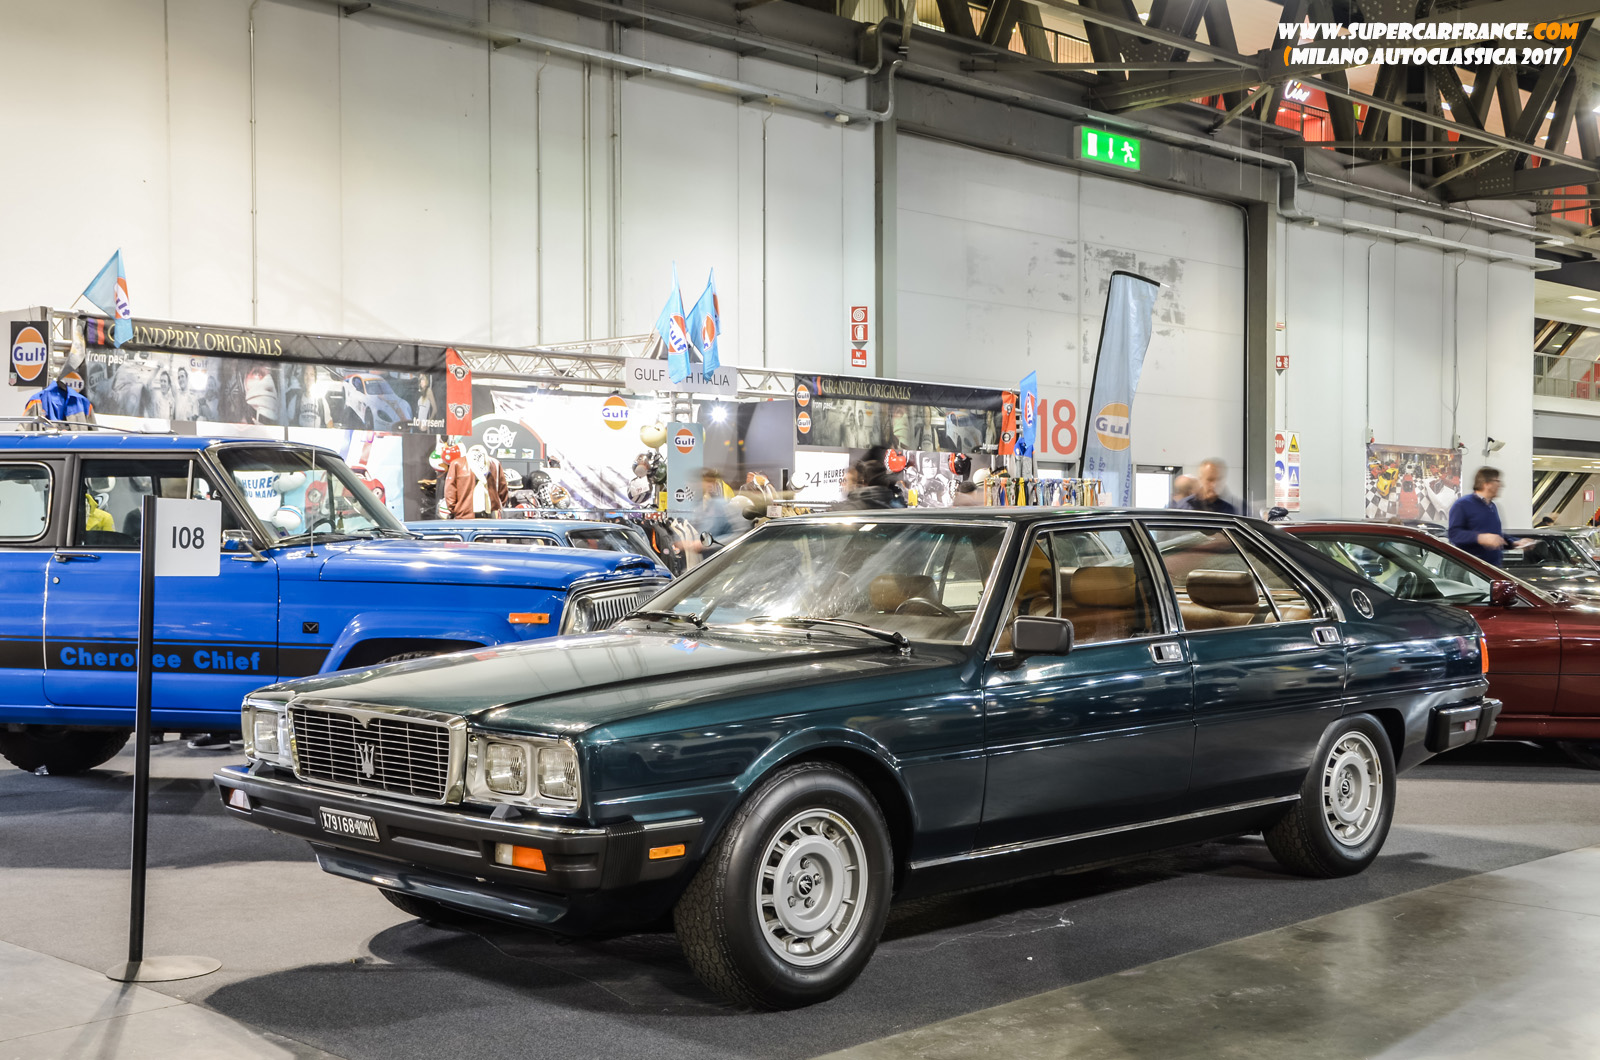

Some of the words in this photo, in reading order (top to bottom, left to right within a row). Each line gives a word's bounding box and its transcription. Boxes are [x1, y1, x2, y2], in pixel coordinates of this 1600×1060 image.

[204, 333, 282, 356] ORIGINALS
[13, 346, 46, 362] Gulf
[88, 351, 107, 362] from
[634, 368, 665, 381] GULF
[822, 380, 870, 397] GRANDPRIX
[870, 383, 912, 400] ORIGINALS
[602, 408, 628, 419] Gulf
[1036, 398, 1078, 455] 18
[1095, 416, 1130, 437] Gul
[674, 436, 695, 446] Gulf
[823, 468, 846, 479] HEURES
[255, 488, 278, 498] MANS
[172, 526, 205, 550] 108
[60, 646, 182, 669] Cheroee
[193, 649, 261, 671] Chief
[322, 812, 355, 833] X79168
